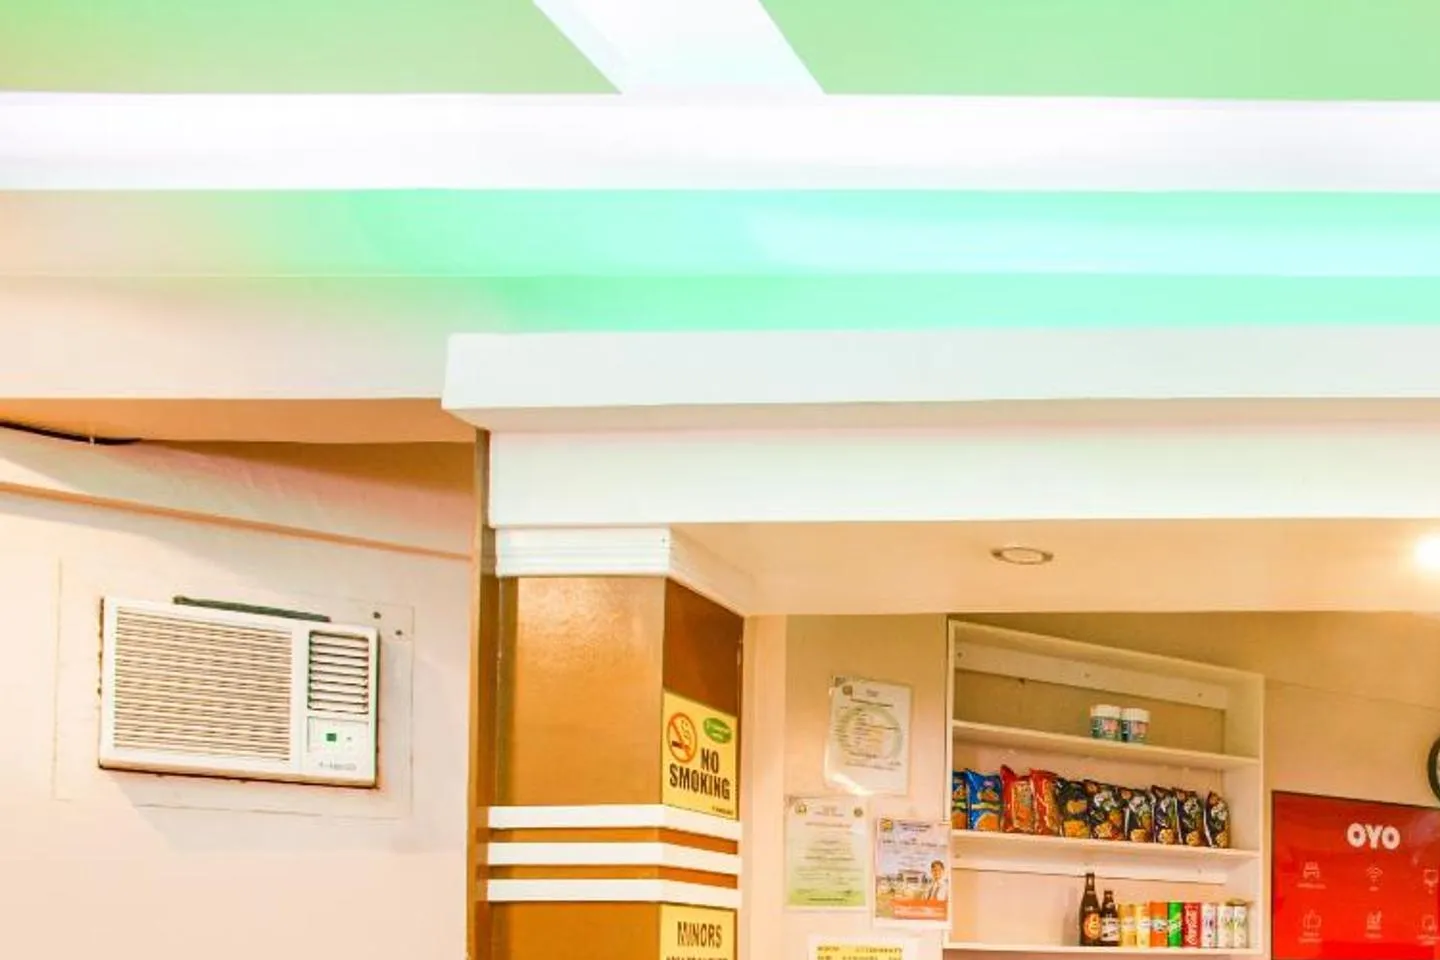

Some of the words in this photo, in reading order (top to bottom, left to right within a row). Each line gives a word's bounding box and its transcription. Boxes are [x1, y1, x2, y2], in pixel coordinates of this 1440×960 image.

[701, 748, 719, 774] NO
[669, 763, 730, 800] SMOKING
[1347, 822, 1401, 850] OYO
[677, 921, 722, 948] MINORS
